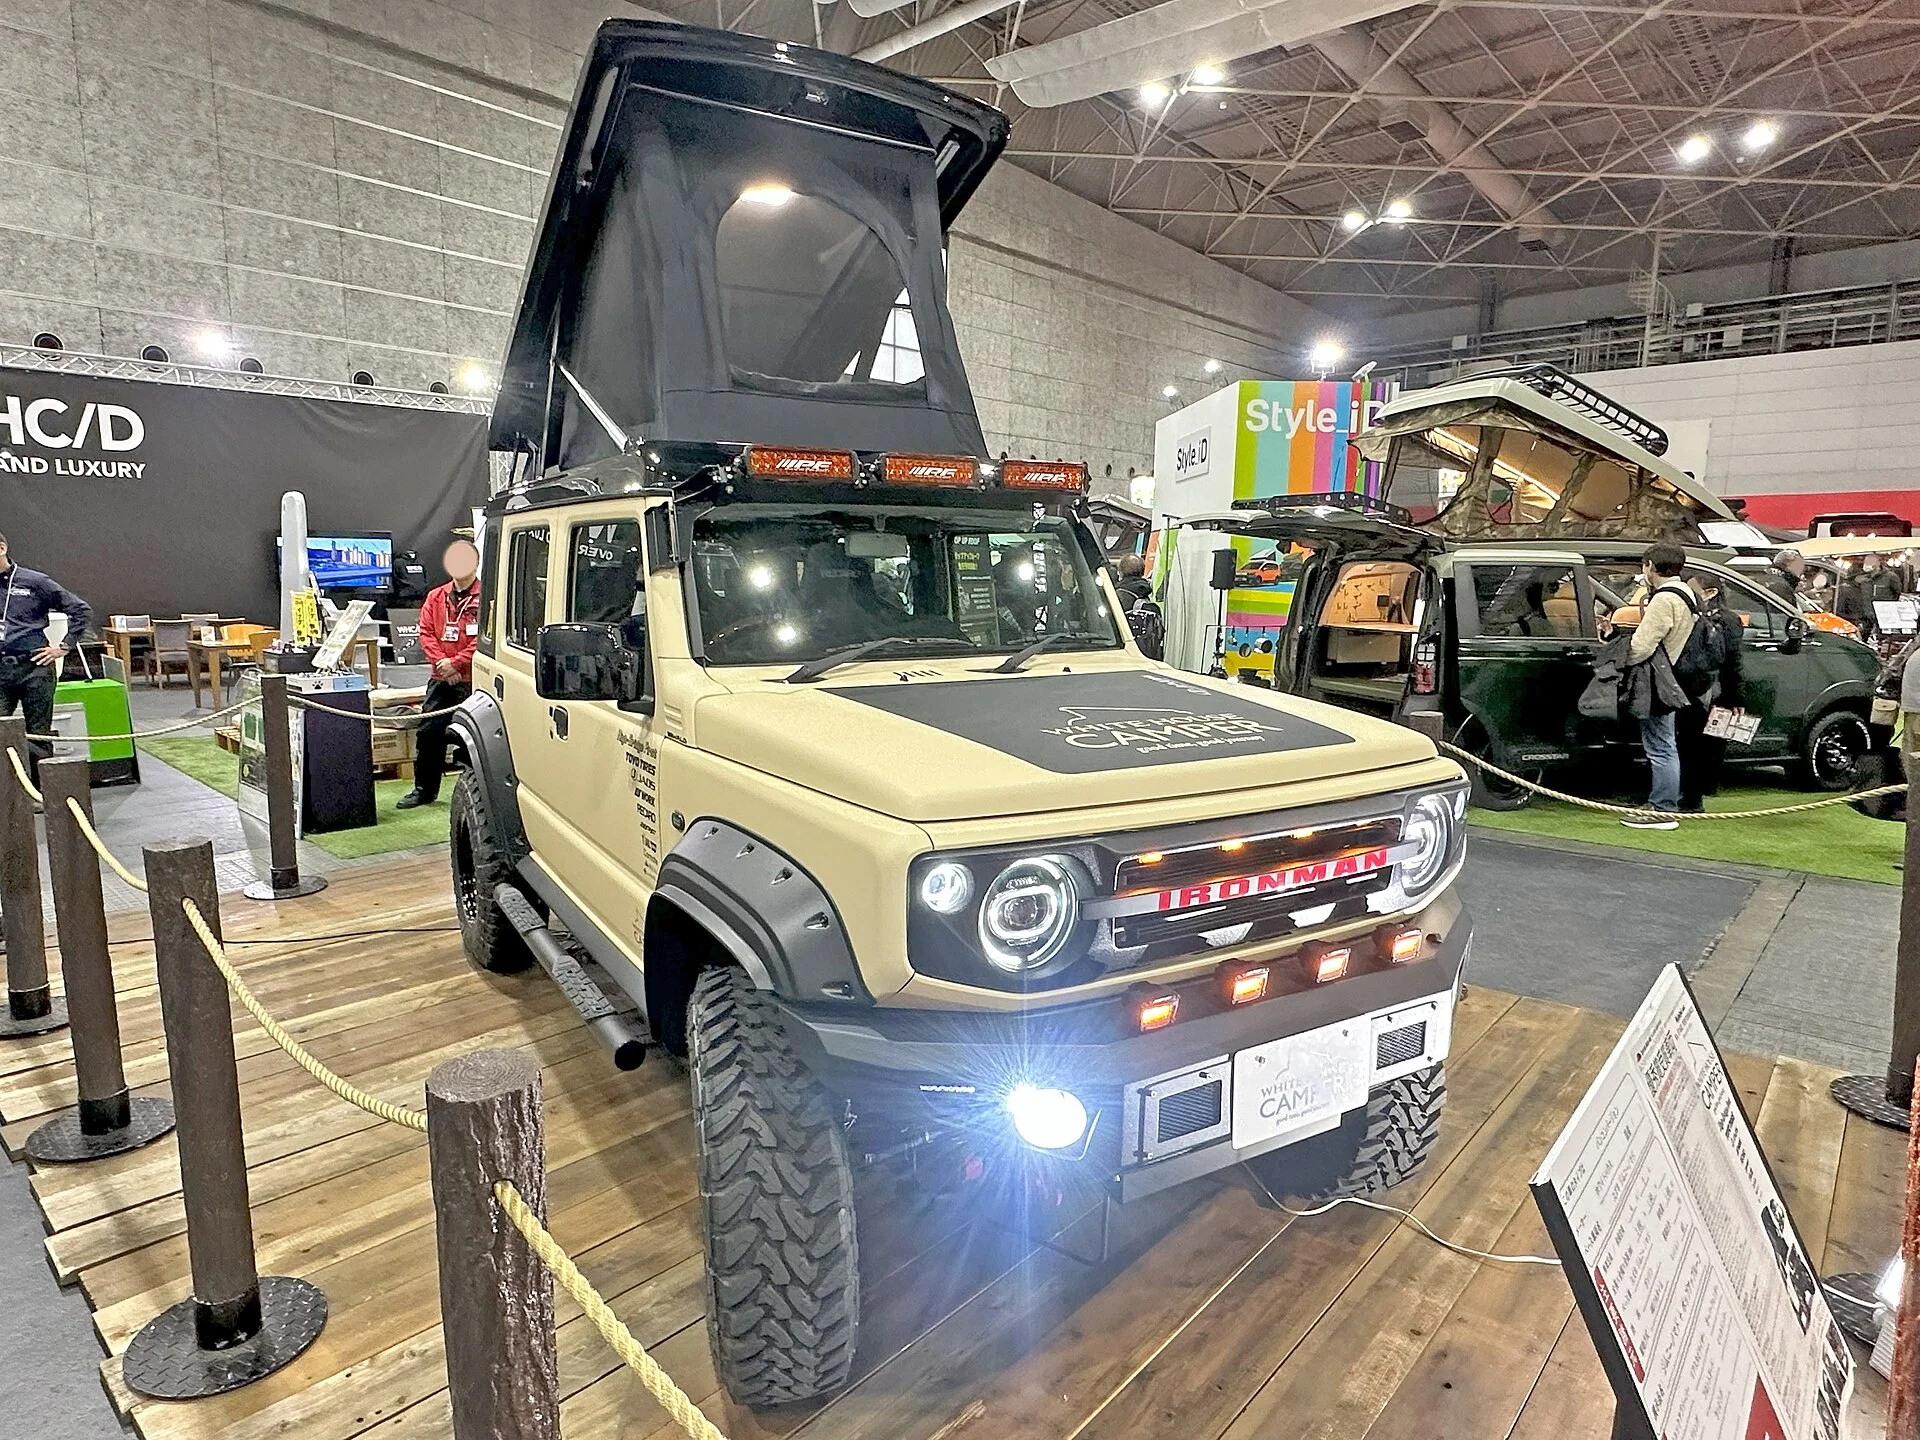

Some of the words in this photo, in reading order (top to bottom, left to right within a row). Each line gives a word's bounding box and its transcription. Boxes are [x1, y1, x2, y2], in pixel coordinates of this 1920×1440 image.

[0, 396, 146, 452] HC/D
[54, 458, 147, 479] LUXURY
[1040, 720, 1151, 735] WHITE
[1147, 712, 1244, 725] HOUSE
[1065, 719, 1284, 749] CAMPER
[1158, 848, 1389, 911] IRONMAN
[1701, 1062, 1725, 1109] CAMPER
